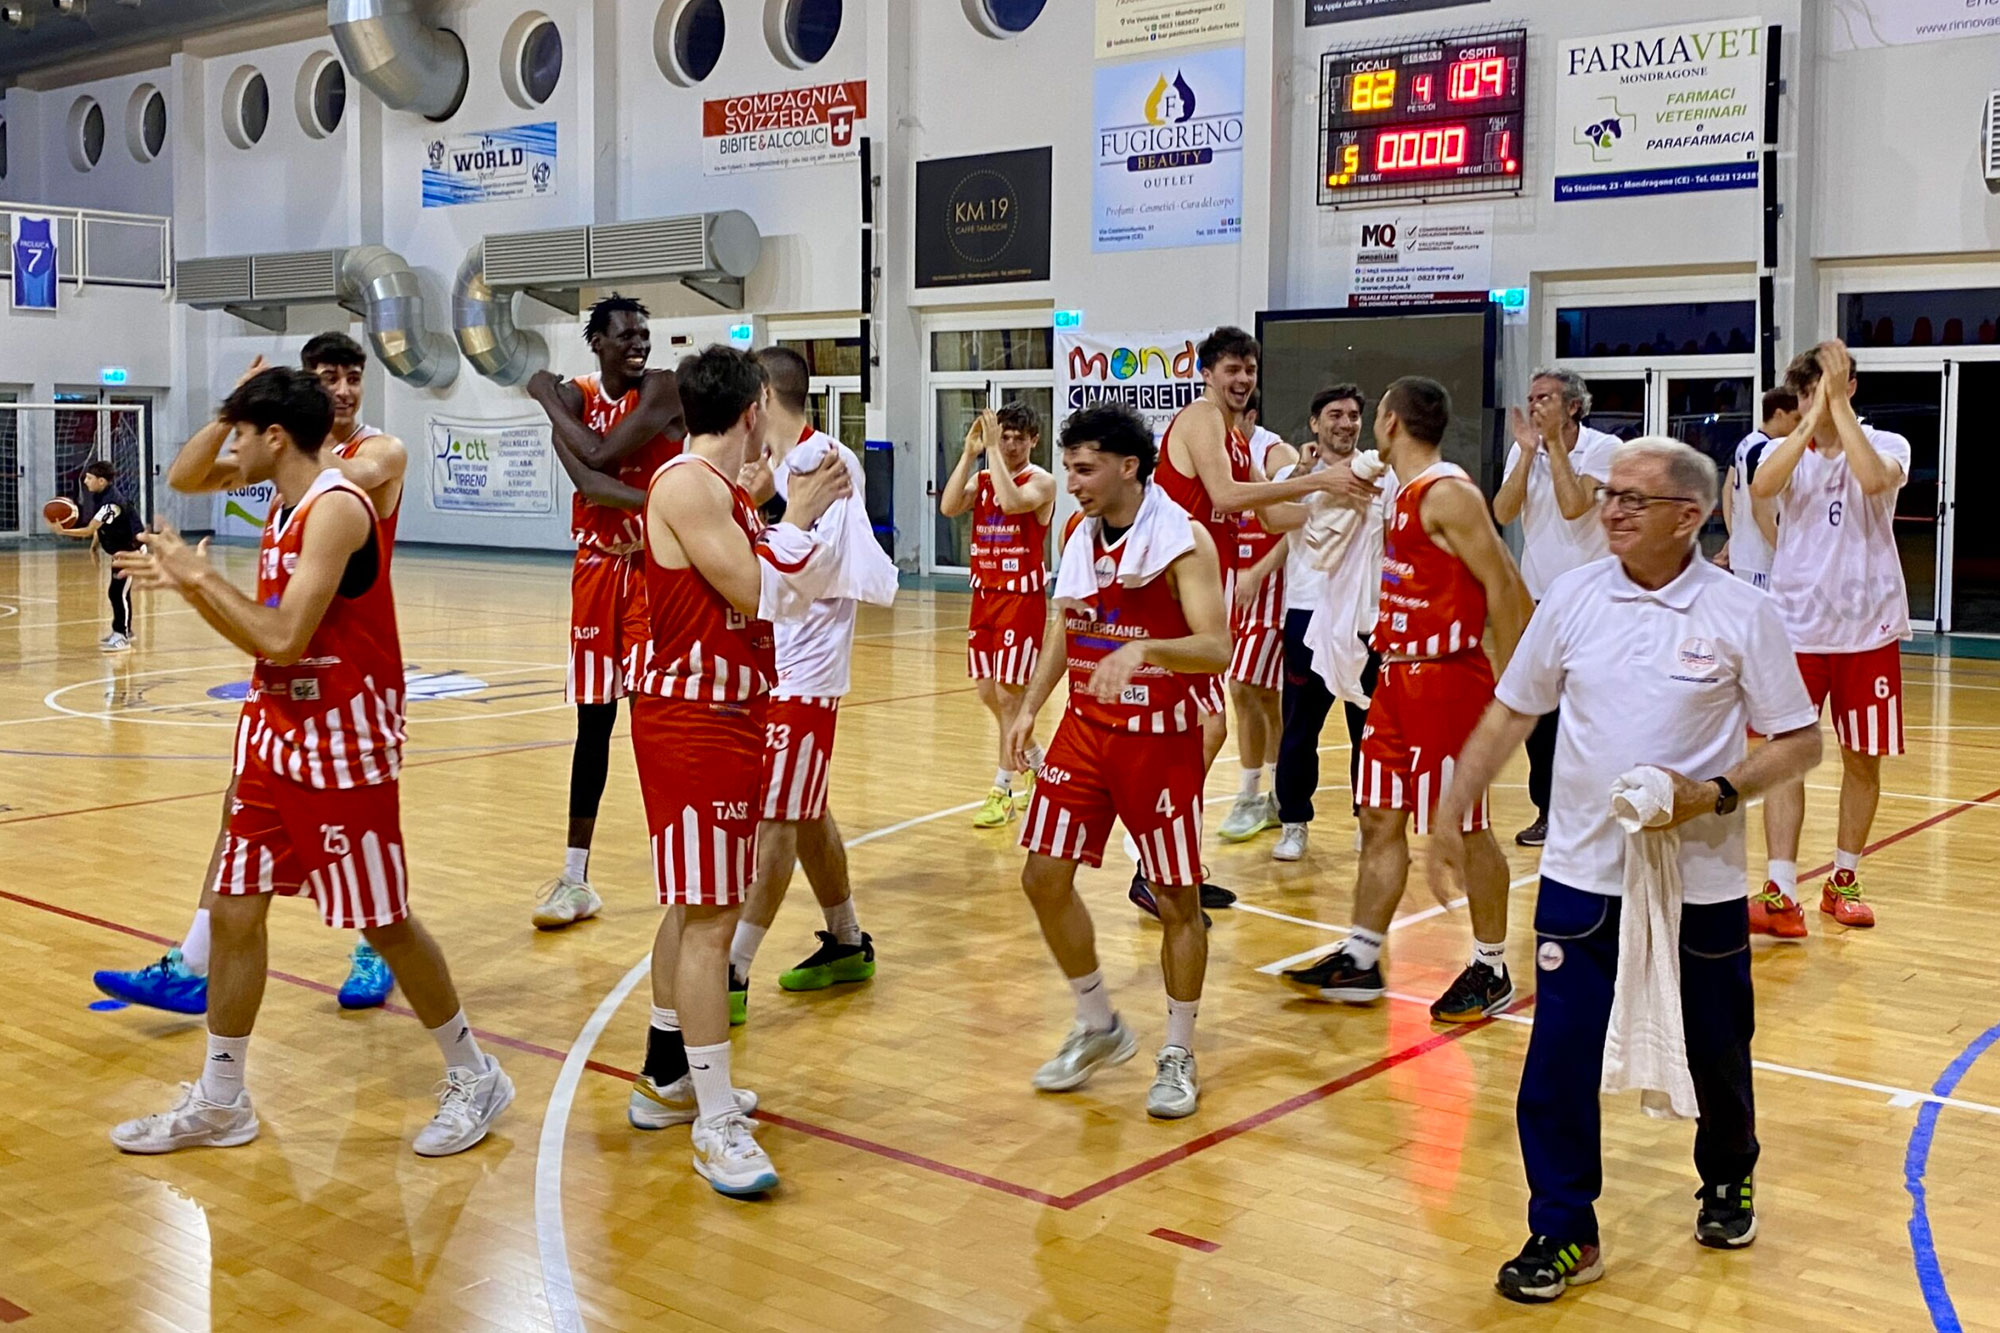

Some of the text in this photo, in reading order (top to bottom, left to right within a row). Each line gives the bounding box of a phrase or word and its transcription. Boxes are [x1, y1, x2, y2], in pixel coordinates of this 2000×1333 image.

[1459, 46, 1497, 61] OSPITI
[1568, 27, 1762, 76] FARMAVET
[1351, 59, 1390, 73] LOCALI
[1620, 67, 1708, 84] MONDRAGONE
[1352, 70, 1396, 111] 82
[1414, 76, 1430, 102] 4
[1450, 58, 1504, 100] 109
[724, 84, 848, 117] COMPAGNIA
[1166, 95, 1177, 118] F
[1666, 88, 1736, 105] FARMACI
[725, 108, 819, 134] SVIZZERA
[1656, 104, 1747, 124] VETERINARI
[1100, 118, 1243, 157] FUGIGRENO
[1500, 132, 1508, 158] 1
[1646, 131, 1754, 150] PARAFARMACIA
[454, 148, 523, 172] WORLD
[1138, 150, 1203, 170] BEAUTY
[1344, 145, 1360, 173] 5
[1144, 175, 1194, 189] OUTLET
[1561, 185, 1573, 194] Via
[1624, 178, 1674, 189] Mondragone
[1674, 176, 1690, 186] (CE)
[955, 198, 1009, 224] KM 19
[1106, 197, 1235, 218] Profumi Cosmetici Cura del corpo
[1361, 224, 1396, 248] MQ
[28, 249, 43, 273] 7
[1068, 340, 1202, 381] mond
[1070, 386, 1206, 408] CAMERETT
[466, 439, 490, 460] ctt
[454, 473, 487, 488] TIRRENO
[1828, 500, 1842, 526] 6
[1004, 629, 1016, 646] 9
[1874, 676, 1890, 698] 6
[765, 722, 792, 750] 33
[1409, 745, 1422, 772] 7
[1155, 788, 1176, 818] 4
[320, 824, 351, 855] 25
